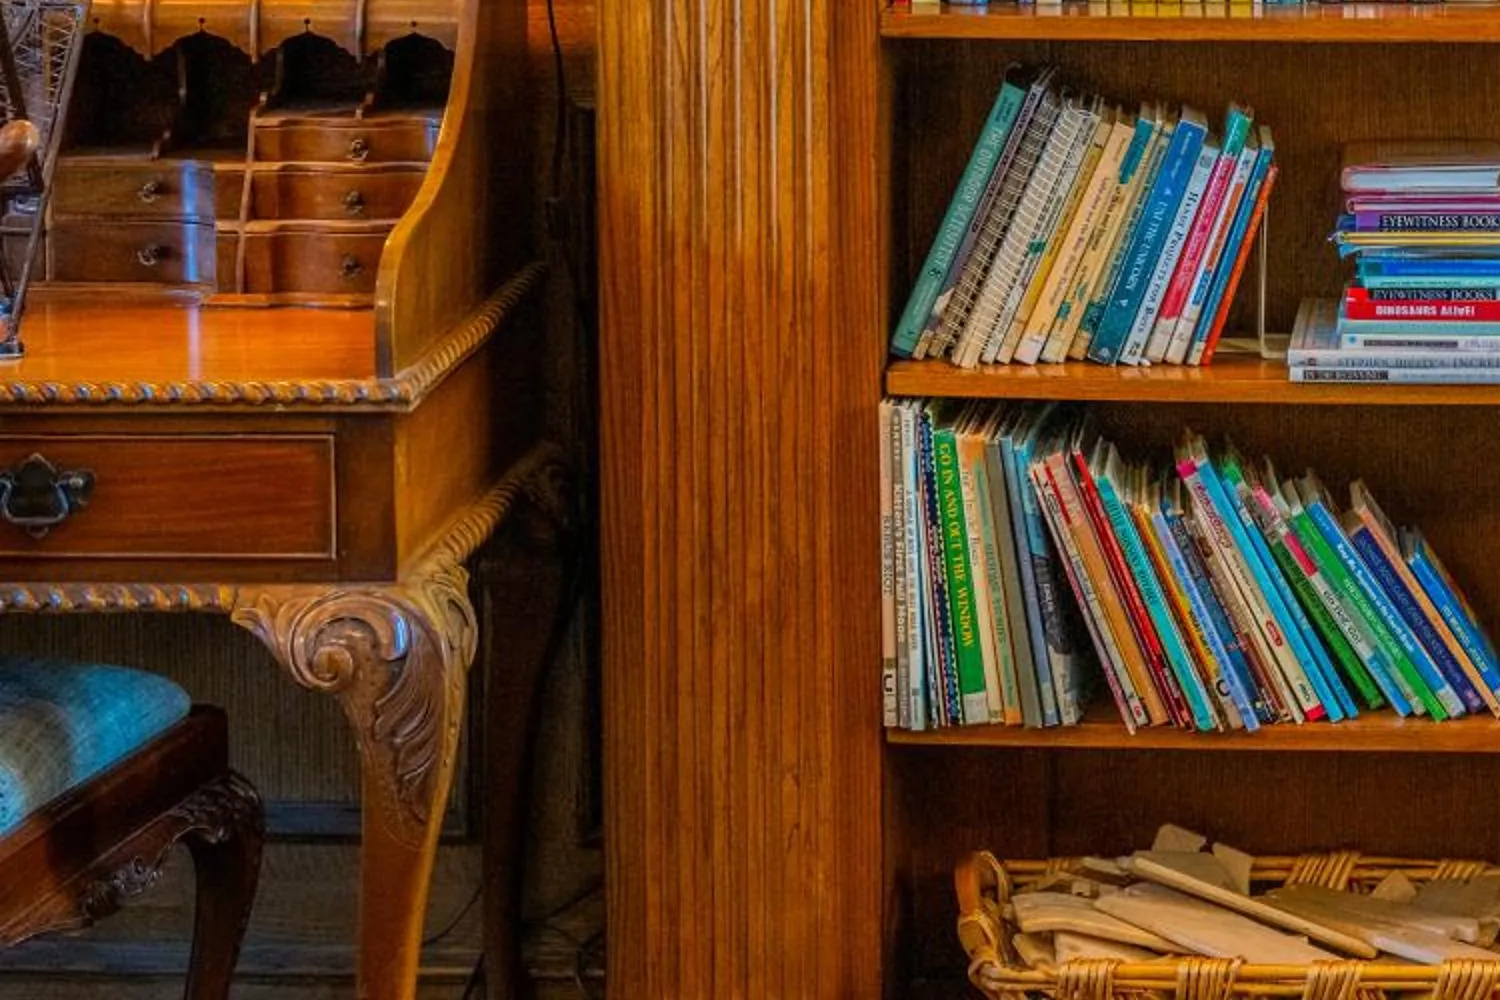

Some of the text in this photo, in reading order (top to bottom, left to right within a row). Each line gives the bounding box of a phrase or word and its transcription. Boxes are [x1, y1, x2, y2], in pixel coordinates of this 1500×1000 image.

[1382, 215, 1459, 229] EYEWITNESS
[1373, 290, 1493, 300] EYEWITNESS BOOKS
[1376, 305, 1437, 316] DINOSAURS
